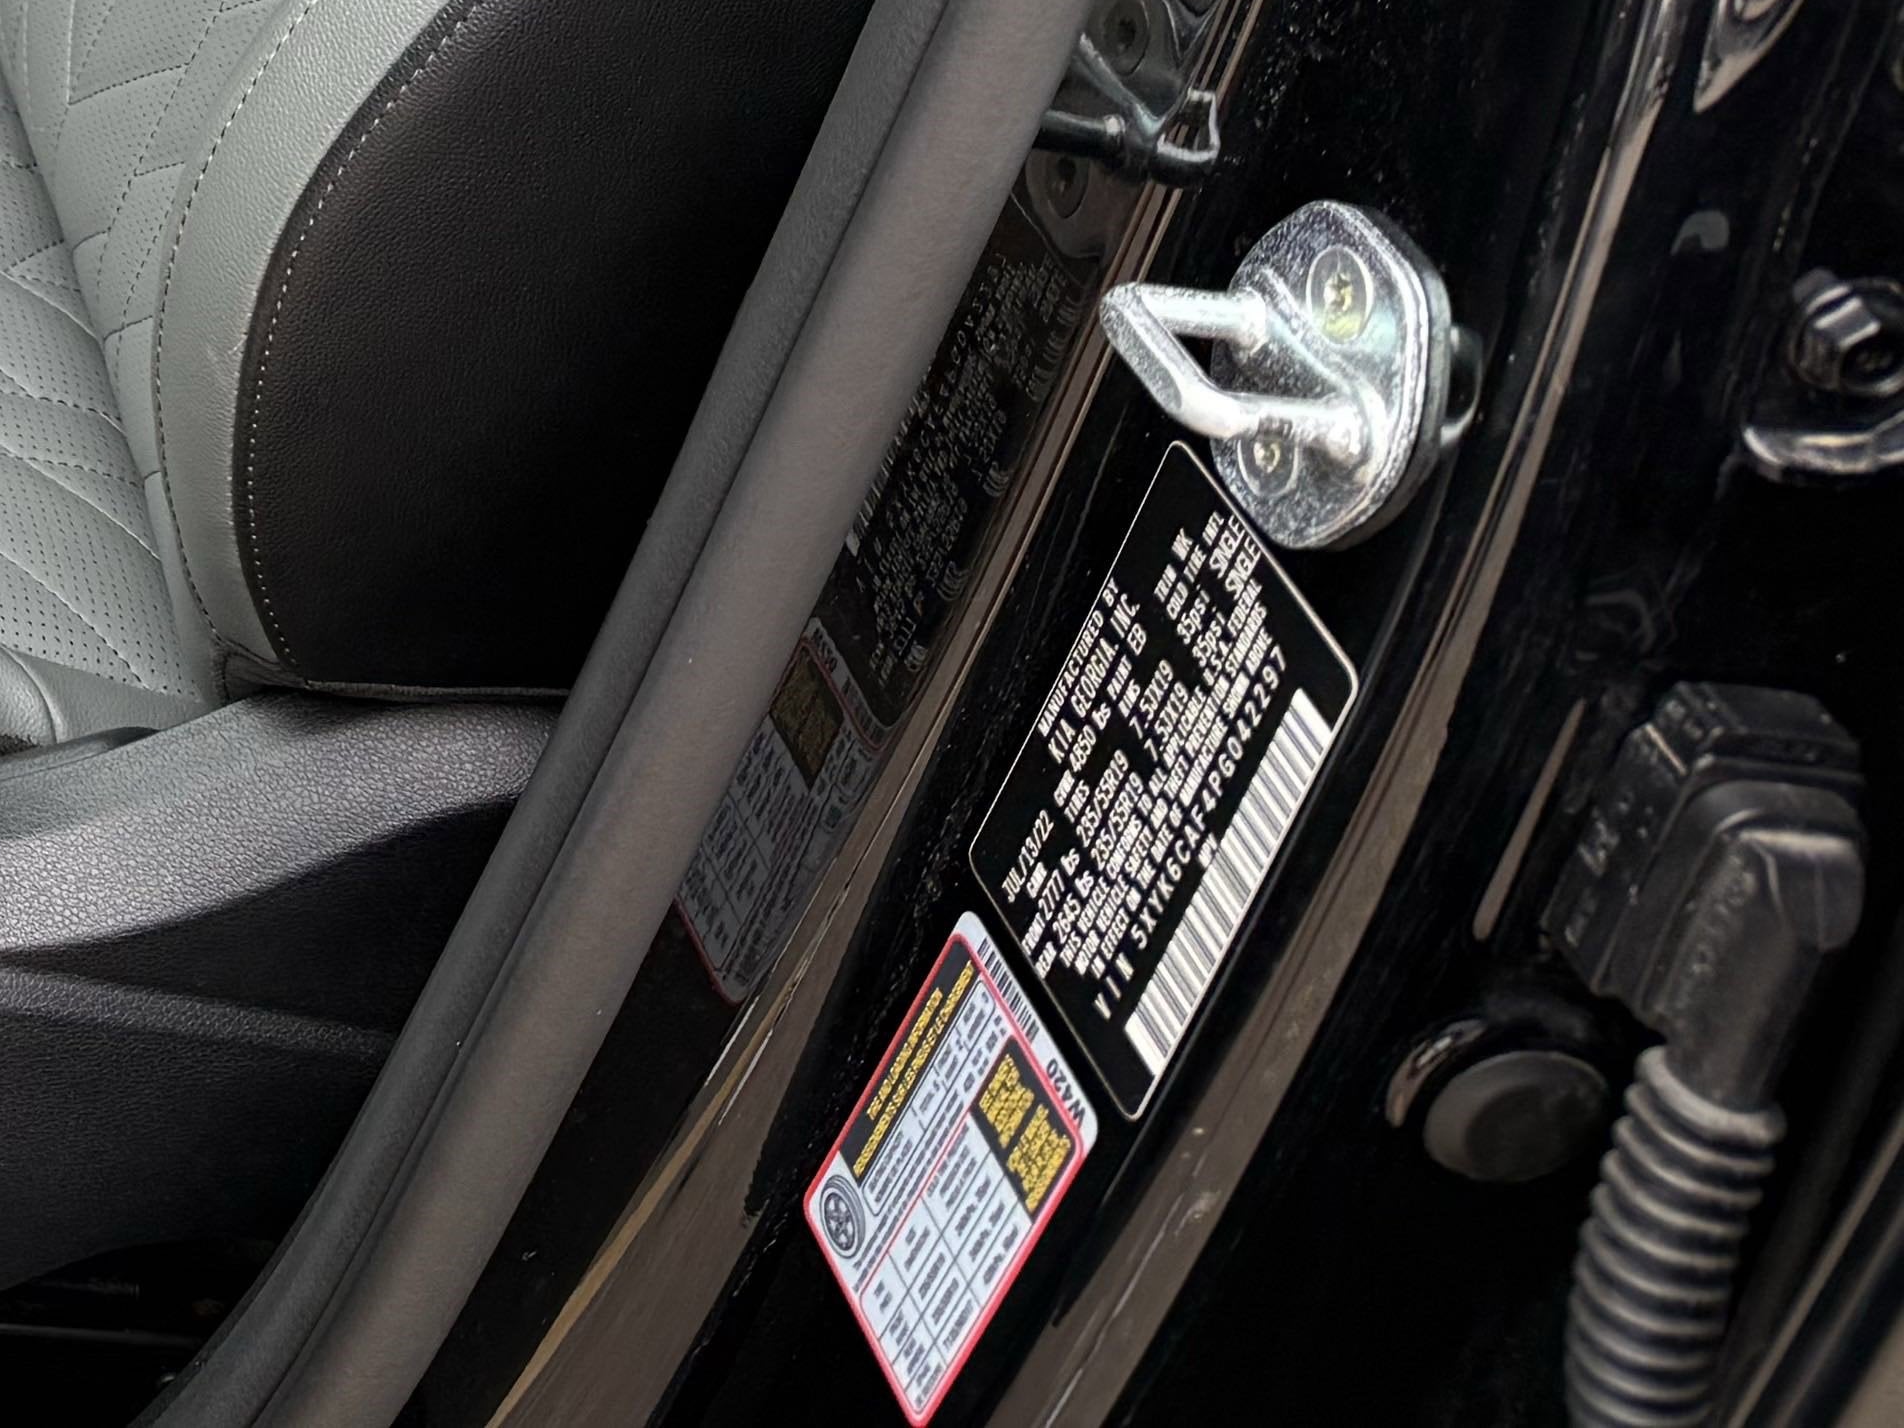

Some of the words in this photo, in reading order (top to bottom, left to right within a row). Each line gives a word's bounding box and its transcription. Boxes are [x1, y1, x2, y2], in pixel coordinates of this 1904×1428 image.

[1032, 929, 1057, 977] REAR
[1052, 892, 1082, 945] 2645
[1090, 771, 1144, 872] 235/55R19
[1143, 681, 1189, 762] 7.5JX19
[1191, 606, 1232, 678] 35psi
[1224, 535, 1263, 603] SINGLE
[1037, 610, 1104, 737] MANUFACTURED
[1102, 577, 1119, 607] BY
[1037, 868, 1065, 921] 2777
[1075, 749, 1129, 848] 235/55R19
[1128, 659, 1174, 739] 7.5JX19
[1176, 584, 1210, 645] 35psi
[1208, 514, 1247, 579] SINGLE
[1047, 718, 1076, 764] KIA
[1109, 593, 1141, 639] INC.
[1059, 930, 1082, 968] THIS
[1076, 875, 1111, 934] VEHICLE
[1105, 813, 1143, 880] CONFORMS
[1136, 793, 1153, 817] TO
[1148, 767, 1168, 798] ALL
[1162, 685, 1207, 769] APPLICABLE
[1226, 578, 1263, 638] FEDERAL
[1063, 779, 1090, 824] TIRES
[1166, 581, 1189, 620] COLD
[1183, 544, 1207, 583] TIRE
[1069, 724, 1097, 773] 4850
[1106, 654, 1132, 701] PAINT
[1127, 623, 1147, 656] EB
[1074, 929, 1101, 976] MOTOR
[1095, 873, 1130, 933] VEHICLE
[1124, 825, 1154, 879] SAFETY
[1149, 797, 1169, 830] AND
[1161, 754, 1189, 800] THEFT
[1183, 674, 1230, 759] PREVENTION
[1224, 601, 1267, 679] STANDARDS
[1090, 954, 1106, 979] IN
[1100, 906, 1130, 961] EFFECT
[1125, 886, 1142, 912] ON
[1135, 858, 1157, 890] THE
[1150, 822, 1175, 864] DATE
[1168, 801, 1183, 828] OF
[1178, 715, 1229, 807] MANUFACTURE
[1222, 671, 1251, 720] SHOWN
[1244, 626, 1273, 676] ABOVE
[1001, 809, 1055, 903] JUL/13/22
[1094, 952, 1134, 1019] VIN
[1130, 645, 1286, 950] 5XYK6CAF4PG042297
[1047, 1058, 1085, 1129] W420
